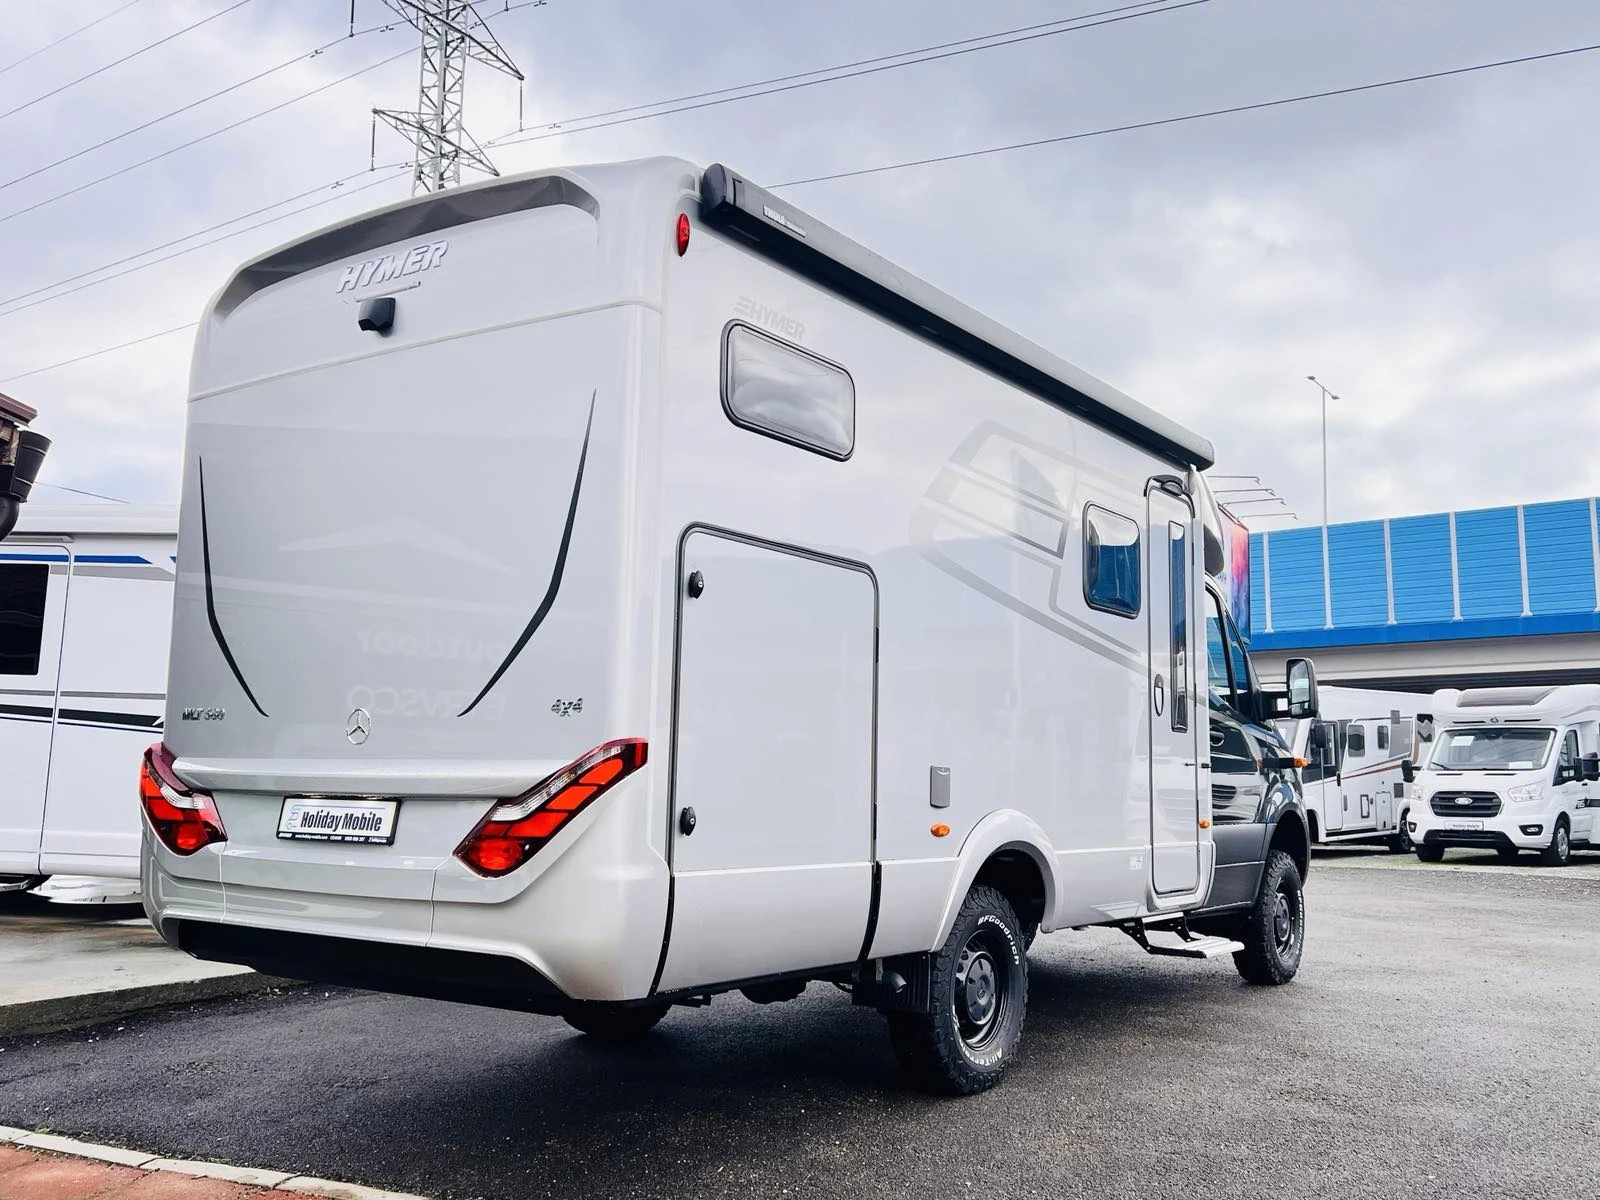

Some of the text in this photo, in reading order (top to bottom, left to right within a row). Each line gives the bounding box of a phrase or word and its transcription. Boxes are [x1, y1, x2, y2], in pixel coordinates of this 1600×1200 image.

[336, 240, 449, 294] HYMER
[749, 299, 806, 342] HYMER
[551, 698, 583, 717] 4x4
[300, 809, 383, 832] Holiday Mobile
[977, 915, 1020, 965] BFGoodrich
